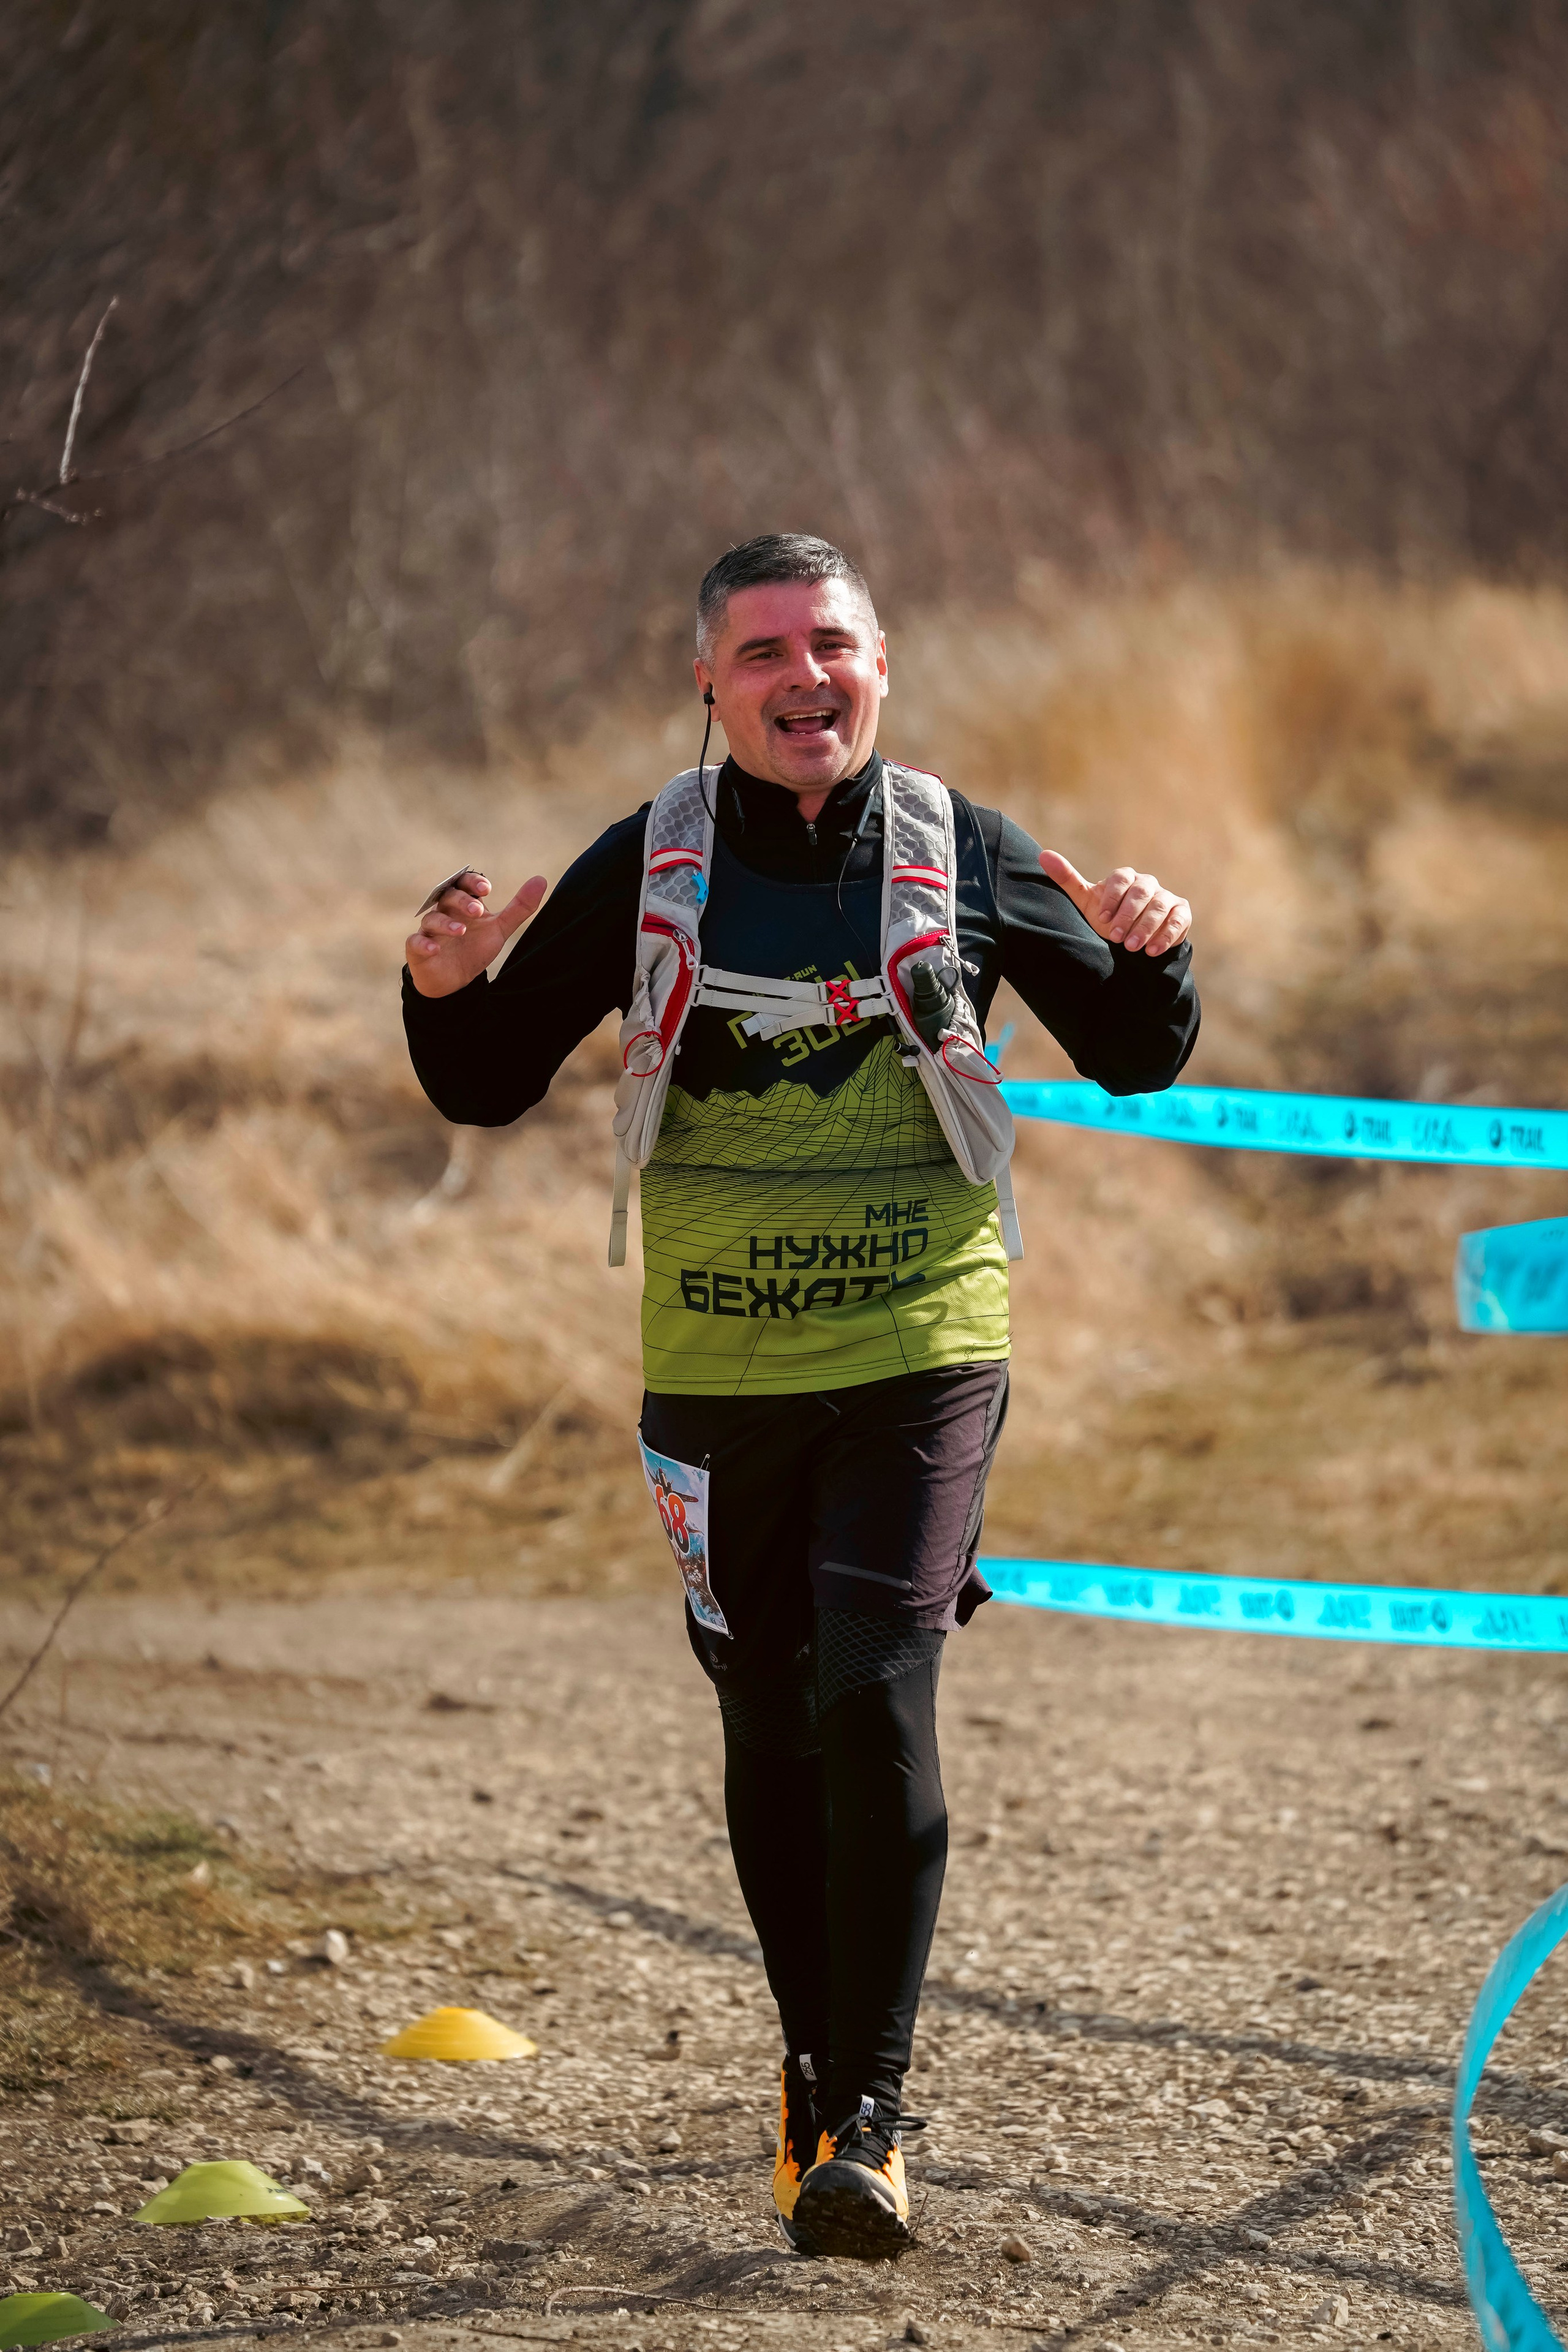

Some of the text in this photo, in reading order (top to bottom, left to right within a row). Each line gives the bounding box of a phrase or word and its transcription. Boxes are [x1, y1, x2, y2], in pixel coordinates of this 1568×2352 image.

[865, 1198, 929, 1228] МНЕ
[750, 1227, 929, 1269] НУЖНО
[655, 1483, 691, 1555] 68
[801, 2062, 814, 2076] 255
[861, 2101, 872, 2117] 55
